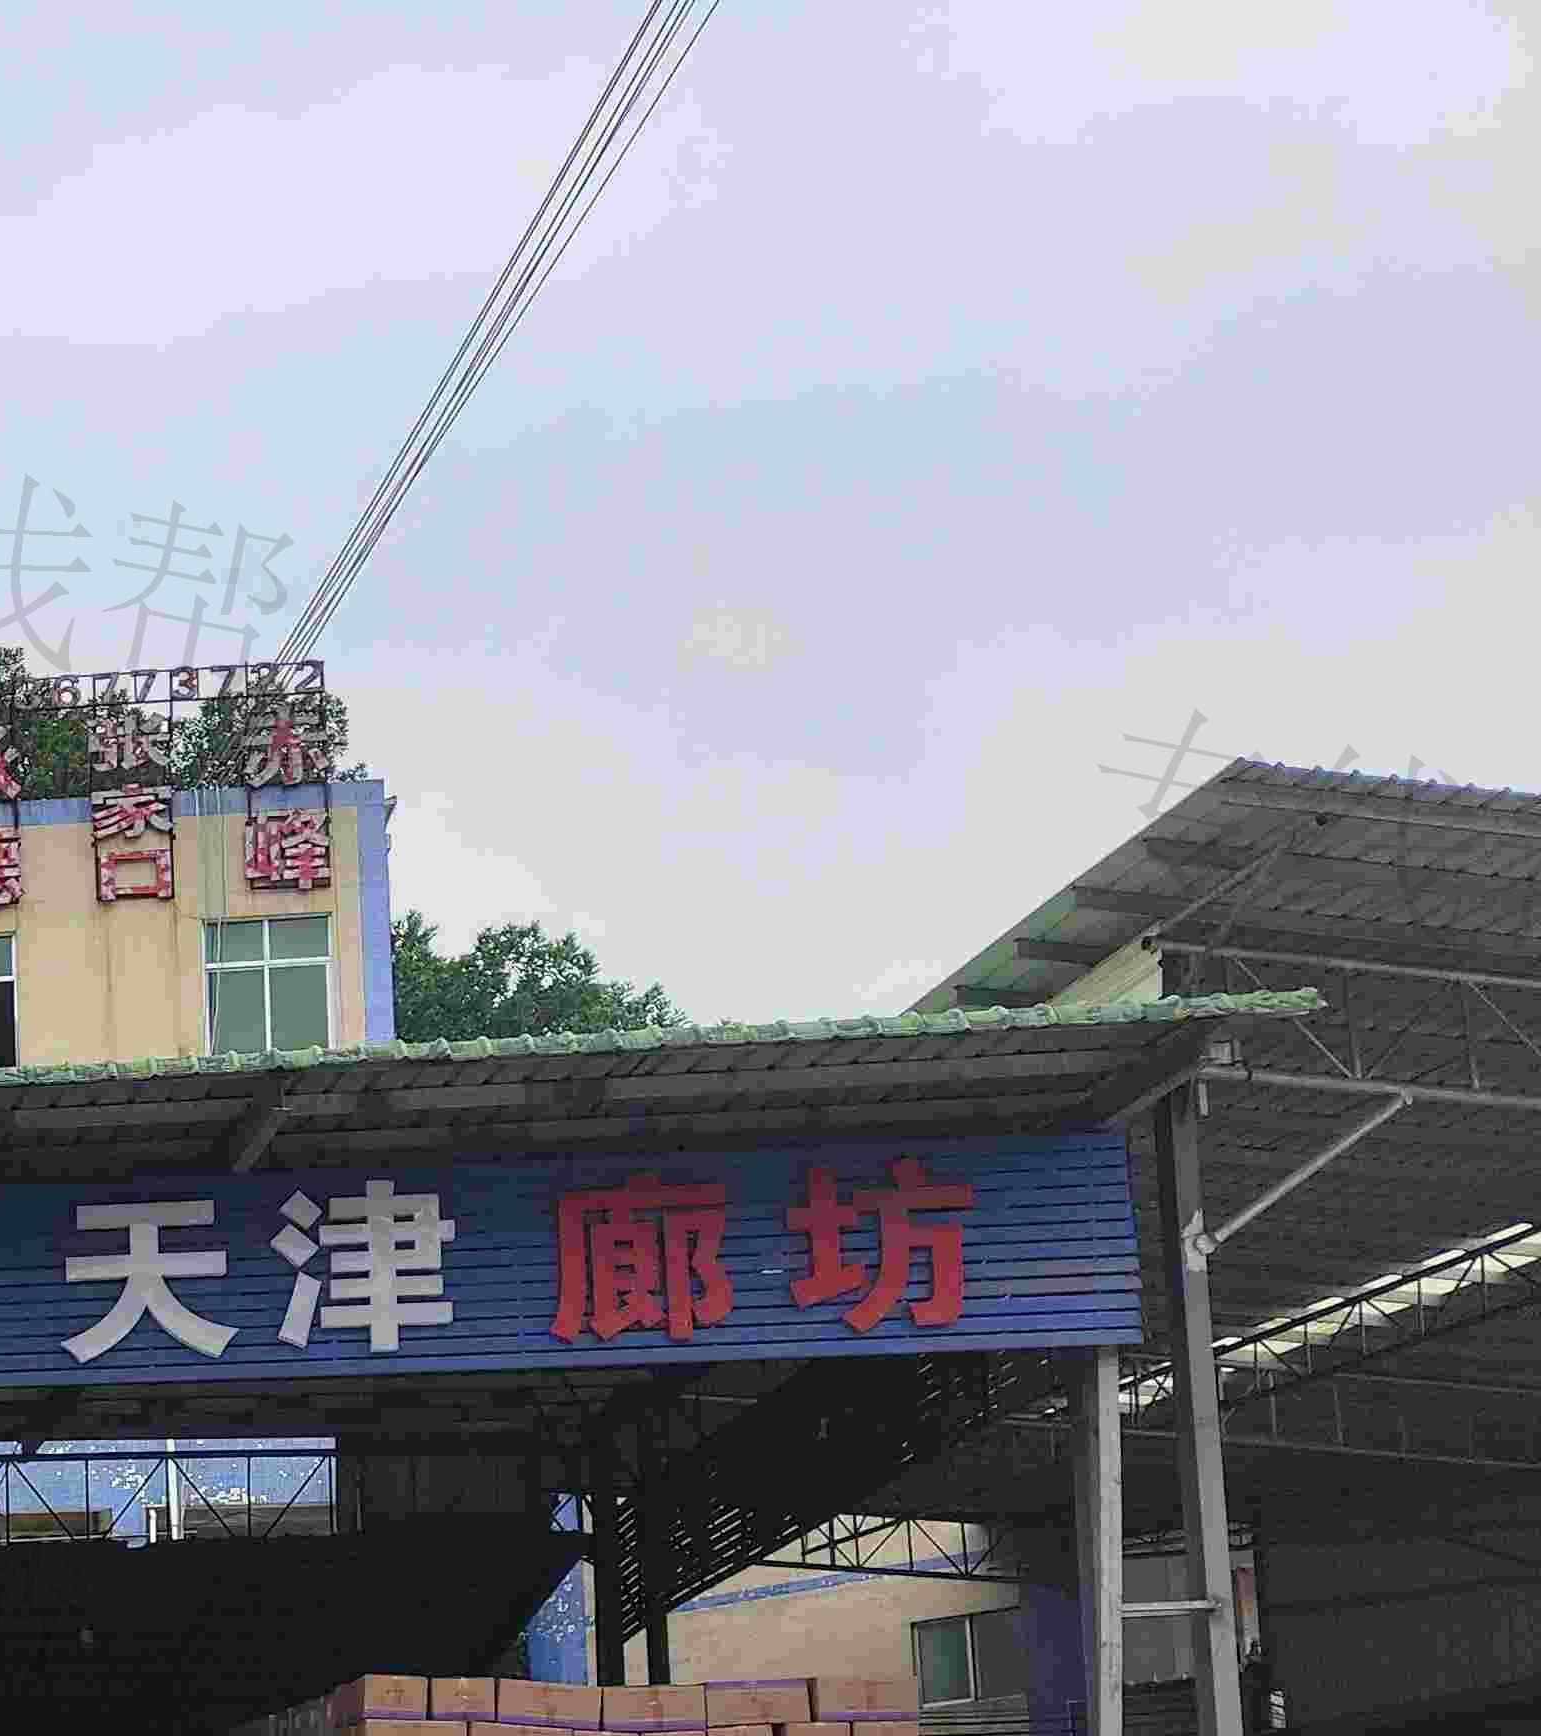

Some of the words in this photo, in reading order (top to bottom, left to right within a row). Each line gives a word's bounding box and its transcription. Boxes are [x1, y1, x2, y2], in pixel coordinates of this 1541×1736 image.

[85, 712, 174, 902] 张家口
[243, 700, 332, 890] 赤峰
[58, 1178, 458, 1362] 天津
[551, 1156, 982, 1348] 廊坊
